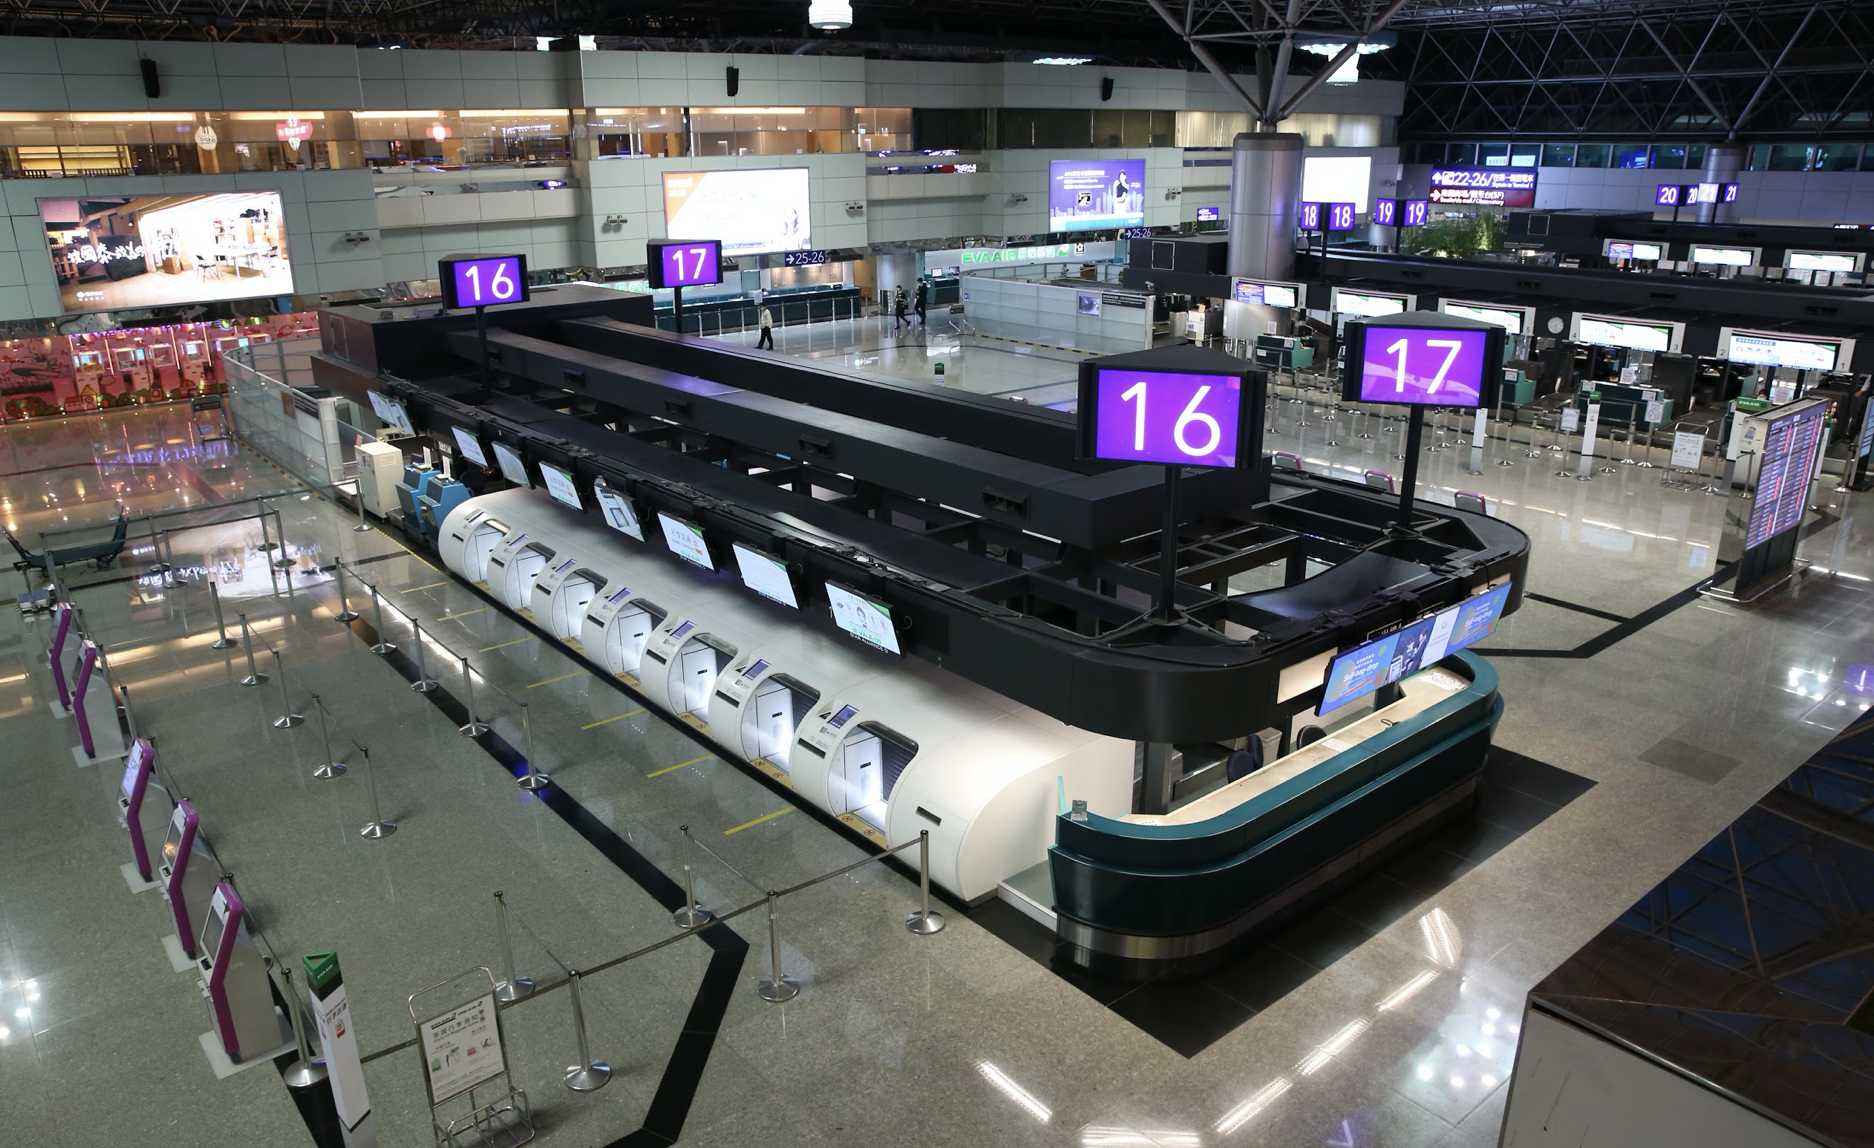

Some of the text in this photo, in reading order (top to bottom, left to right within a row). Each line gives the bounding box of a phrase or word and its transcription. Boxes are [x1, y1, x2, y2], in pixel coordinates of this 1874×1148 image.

[1659, 187, 1676, 203] 20
[1687, 187, 1698, 203] 20
[1700, 185, 1716, 202] 21
[1725, 185, 1737, 202] 21
[1304, 206, 1317, 227] 18
[1334, 206, 1351, 228] 18
[1378, 202, 1393, 222] 19
[1407, 203, 1425, 224] 19
[1131, 228, 1152, 238] 25-26
[672, 248, 707, 281] 17
[795, 251, 825, 265] 25-26
[465, 263, 514, 301] 16
[1720, 348, 1726, 356] 2
[1386, 338, 1462, 395] 17
[1120, 381, 1221, 457] 16
